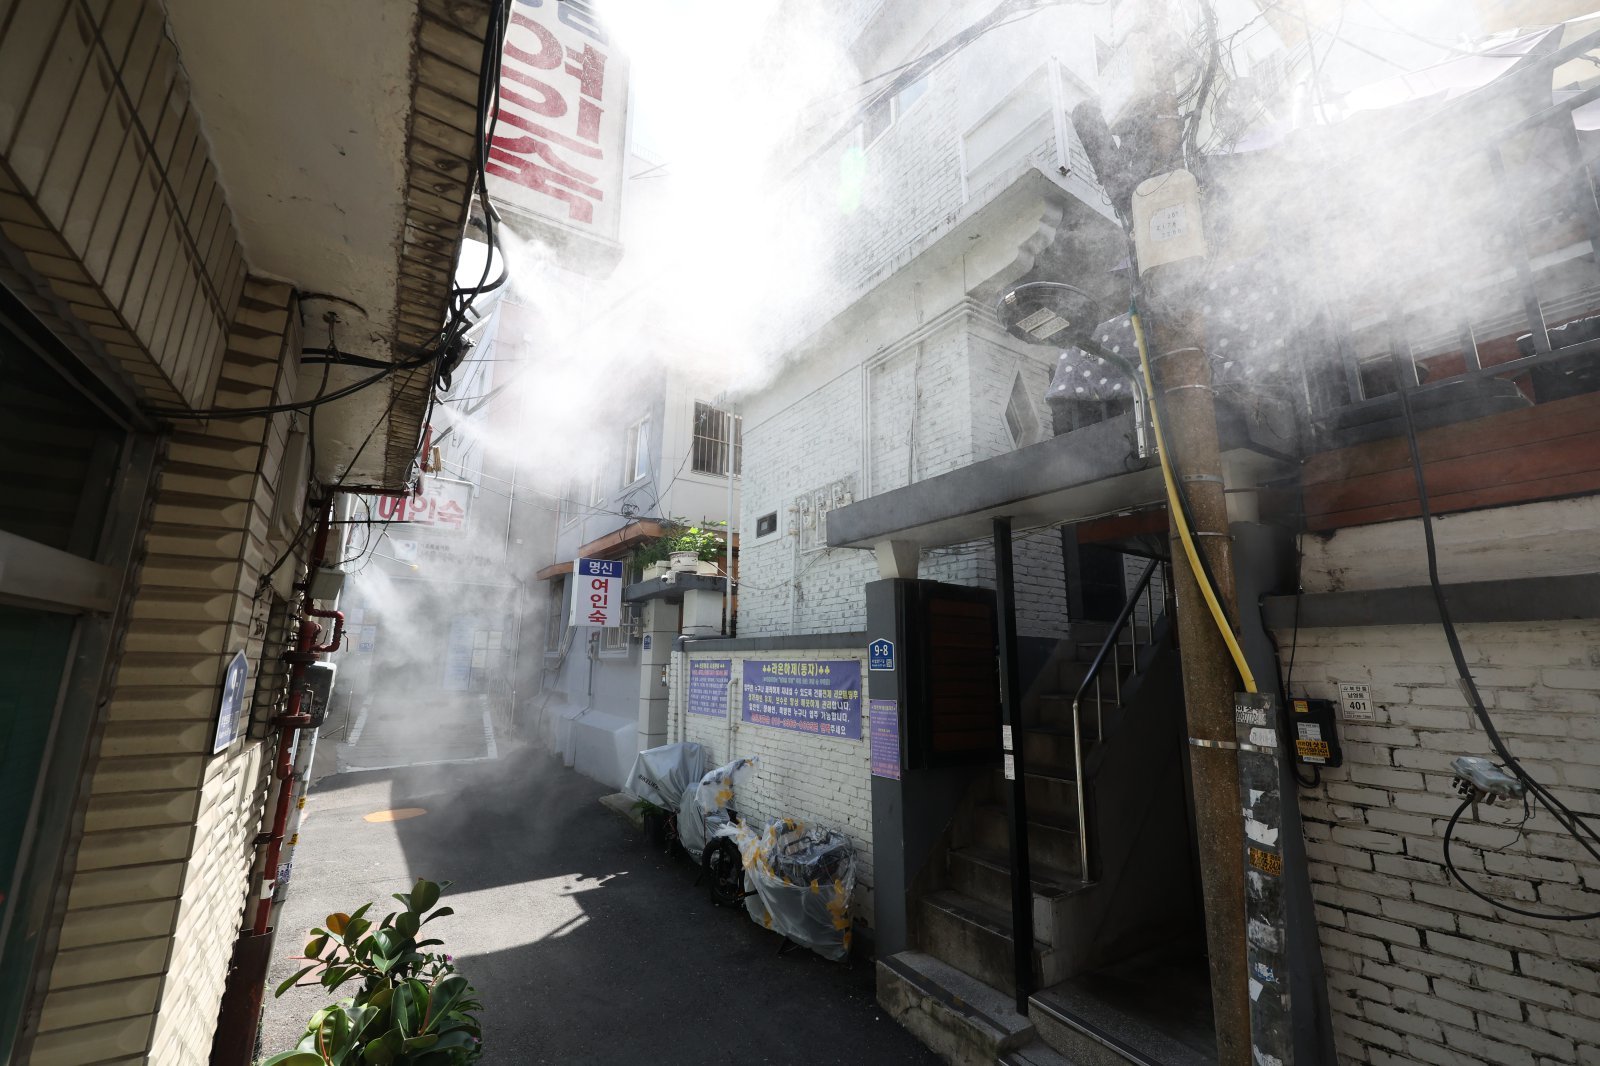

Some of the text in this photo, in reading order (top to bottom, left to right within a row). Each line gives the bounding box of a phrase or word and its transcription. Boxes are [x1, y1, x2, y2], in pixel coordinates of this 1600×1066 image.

[485, 11, 608, 225] 여인숙
[378, 496, 465, 529] 여인숙
[589, 561, 613, 575] 명신
[588, 578, 609, 626] 여인숙
[874, 644, 889, 657] 9-8
[1349, 701, 1367, 711] 401
[821, 710, 850, 723] 가능합니다.
